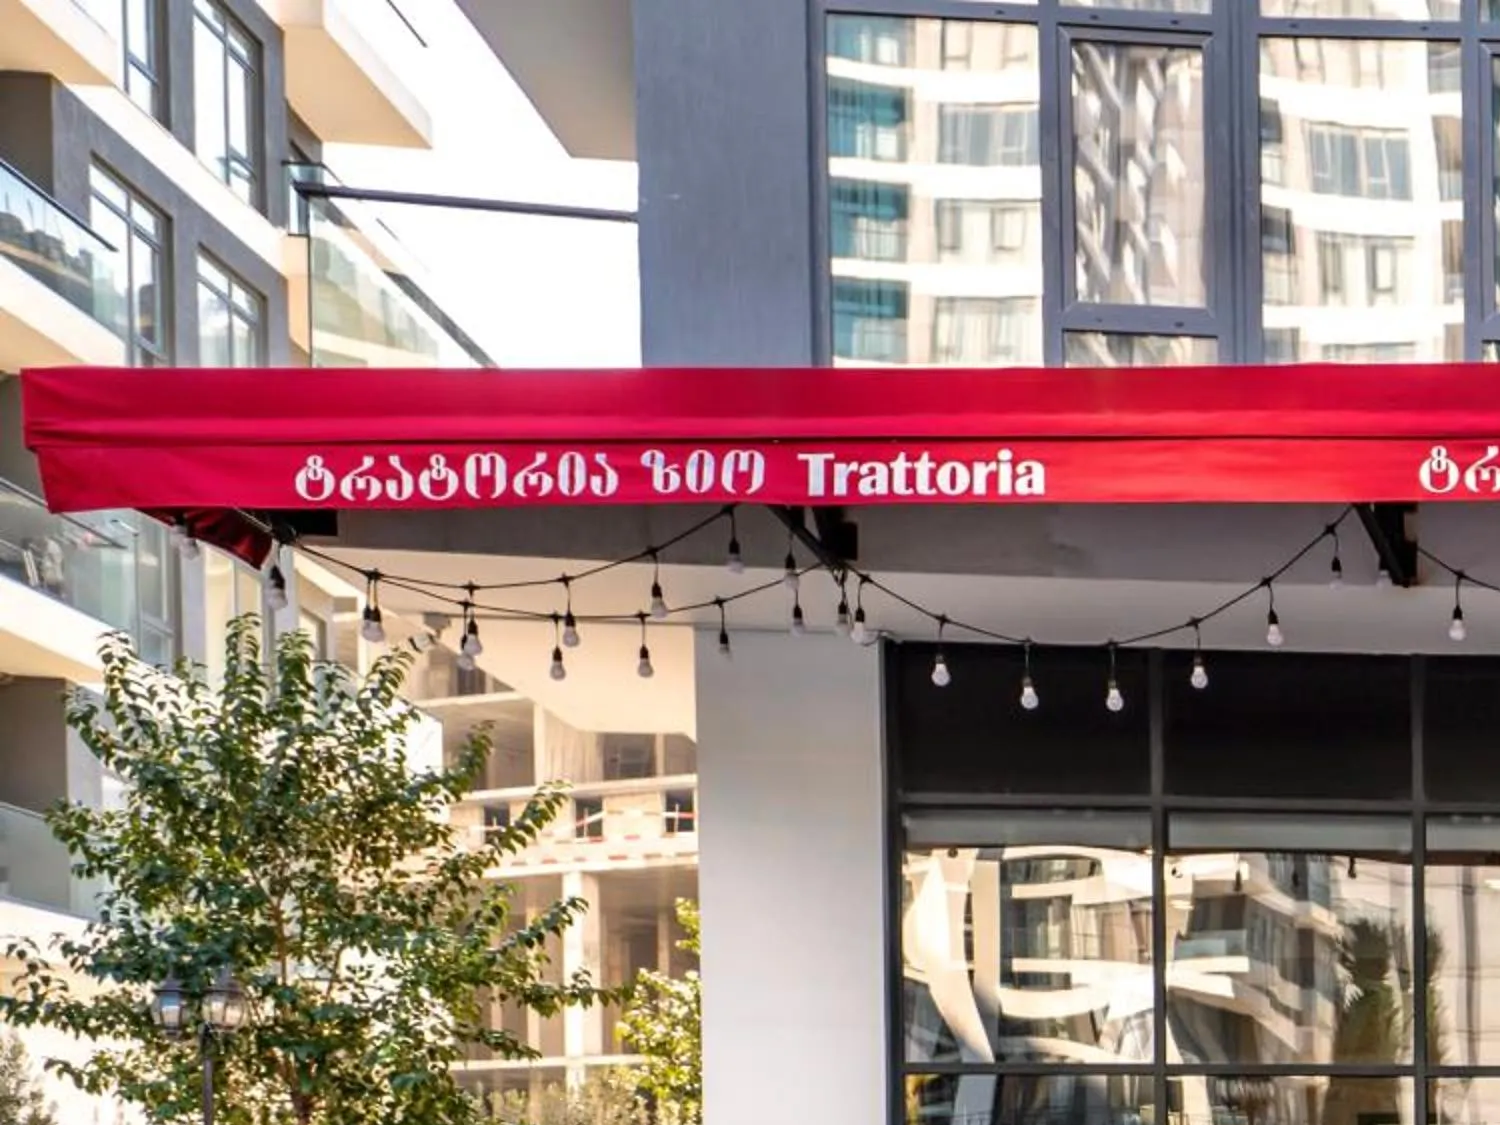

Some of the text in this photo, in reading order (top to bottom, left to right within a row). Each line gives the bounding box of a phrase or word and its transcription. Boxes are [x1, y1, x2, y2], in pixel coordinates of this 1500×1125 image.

[295, 449, 765, 501] ტრატორია ზიო
[797, 448, 1046, 496] Trattoria
